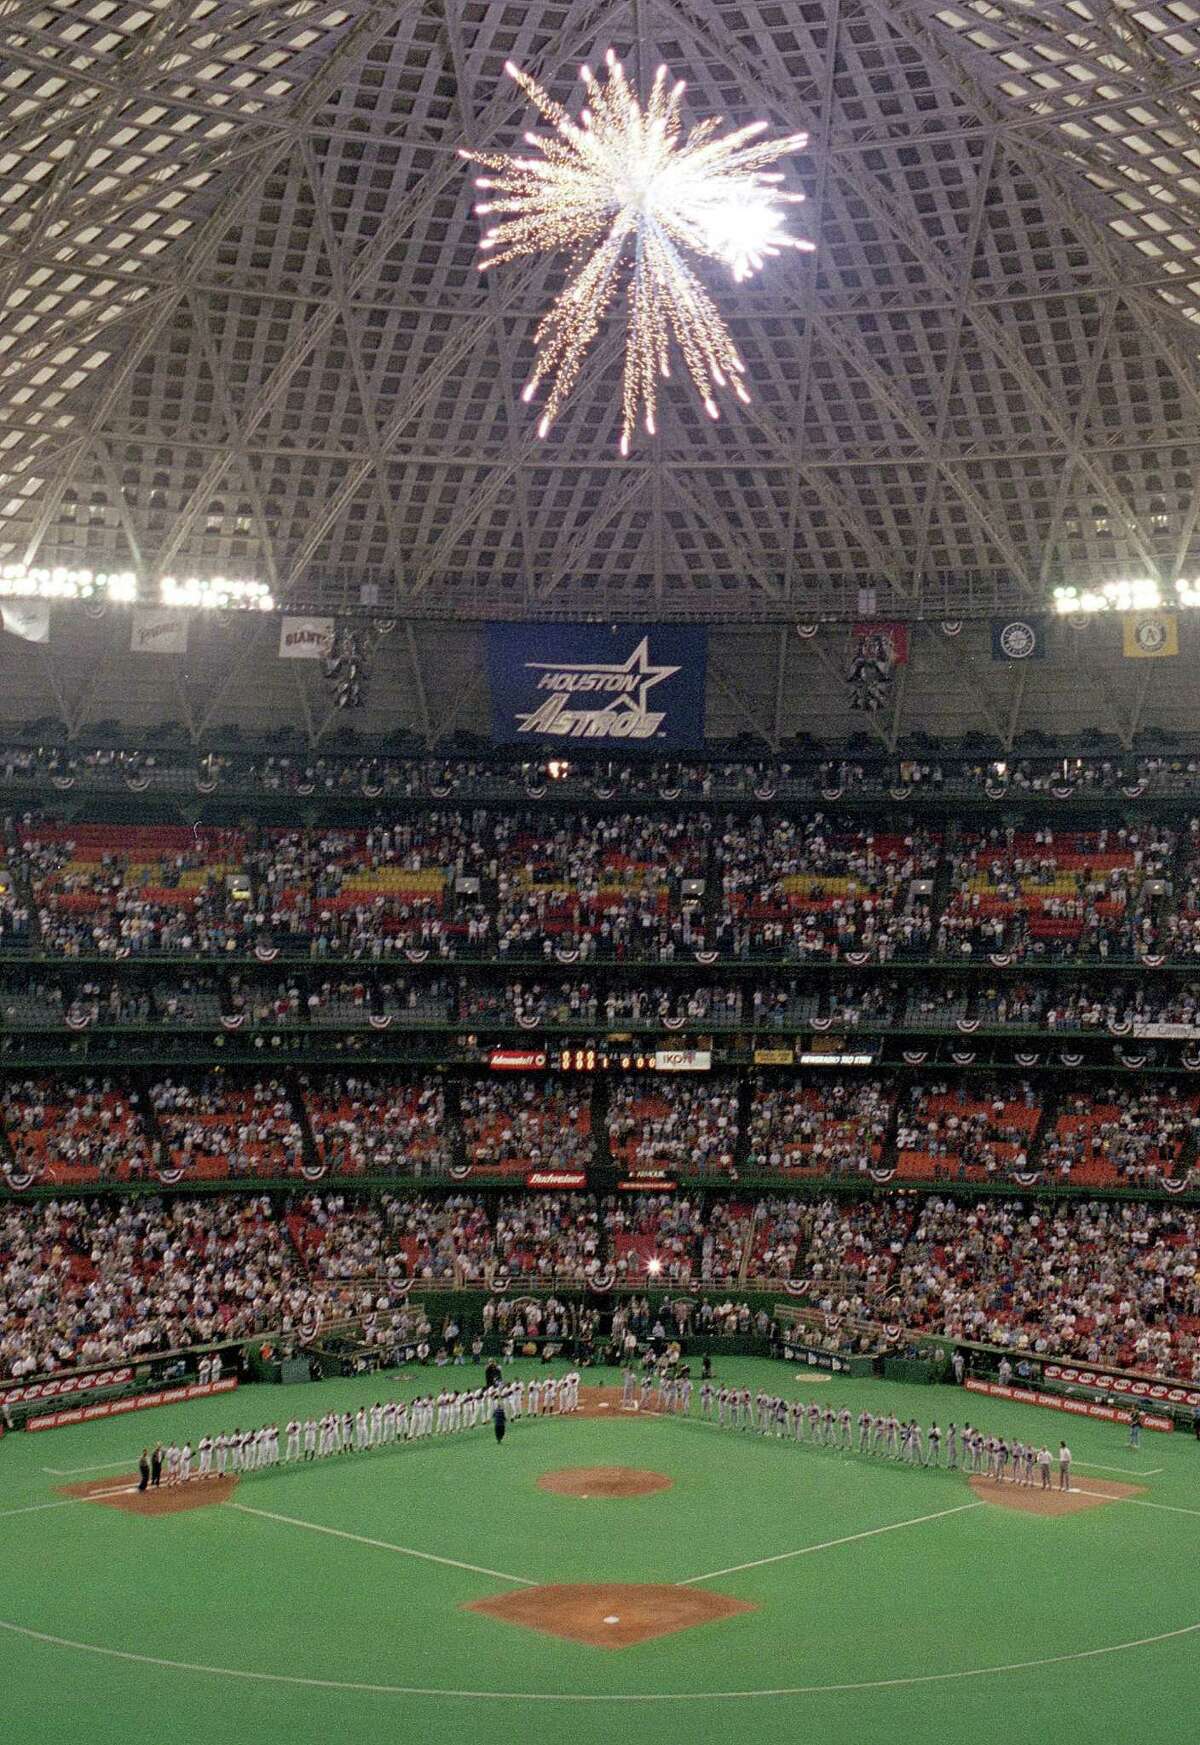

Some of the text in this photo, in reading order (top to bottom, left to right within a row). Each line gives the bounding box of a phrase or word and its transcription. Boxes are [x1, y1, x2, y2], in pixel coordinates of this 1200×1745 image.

[286, 631, 330, 647] GIANT
[537, 673, 642, 692] HOUSTON
[530, 1173, 585, 1184] Budweiser
